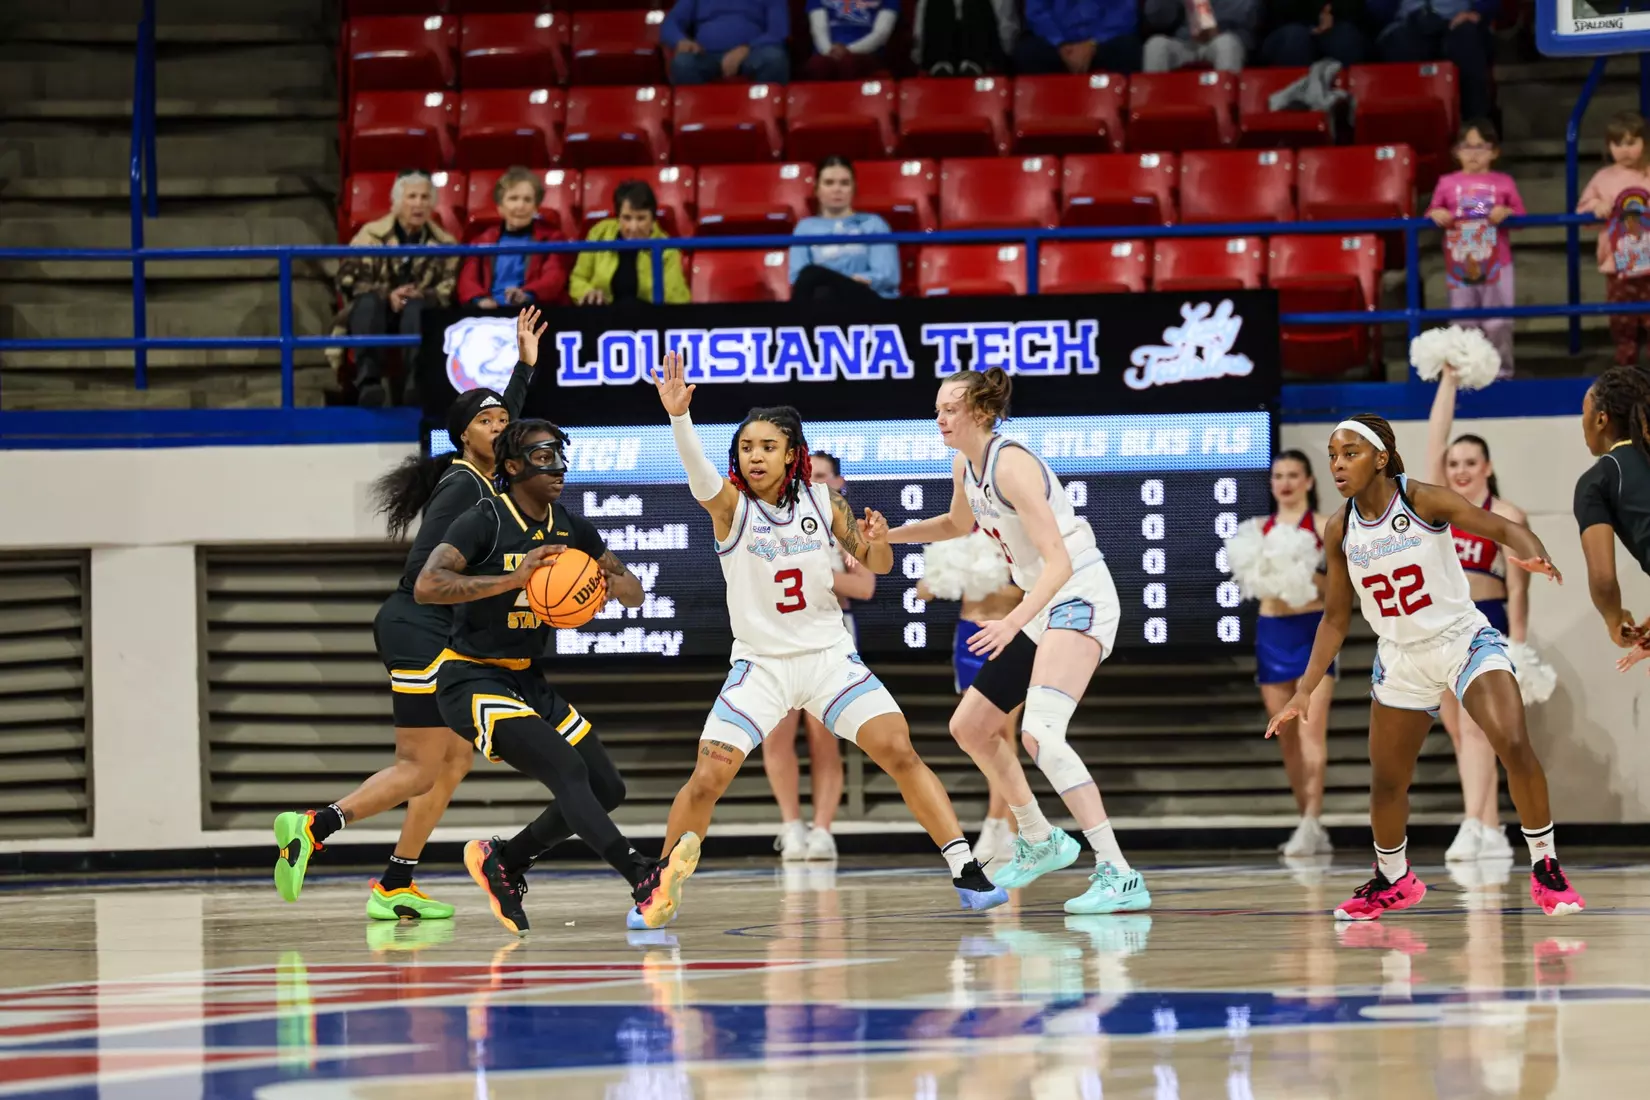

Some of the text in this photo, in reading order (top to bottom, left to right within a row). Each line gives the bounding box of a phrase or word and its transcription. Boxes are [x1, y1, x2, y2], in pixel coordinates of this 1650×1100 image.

[1574, 18, 1624, 33] SPALDING
[556, 319, 1100, 387] LOUISIANA TECH
[1201, 426, 1253, 455] FLS
[583, 478, 1238, 517] Lee 0 0 0 0
[1142, 513, 1165, 540] 0
[1214, 512, 1239, 539] 0
[902, 553, 926, 580] 0
[1142, 548, 1167, 575] 0
[774, 568, 807, 615] 3
[1143, 583, 1167, 609] 0
[1216, 581, 1240, 608] 0
[1361, 563, 1434, 618] 22
[556, 616, 1241, 657] Bradley 0 0 0
